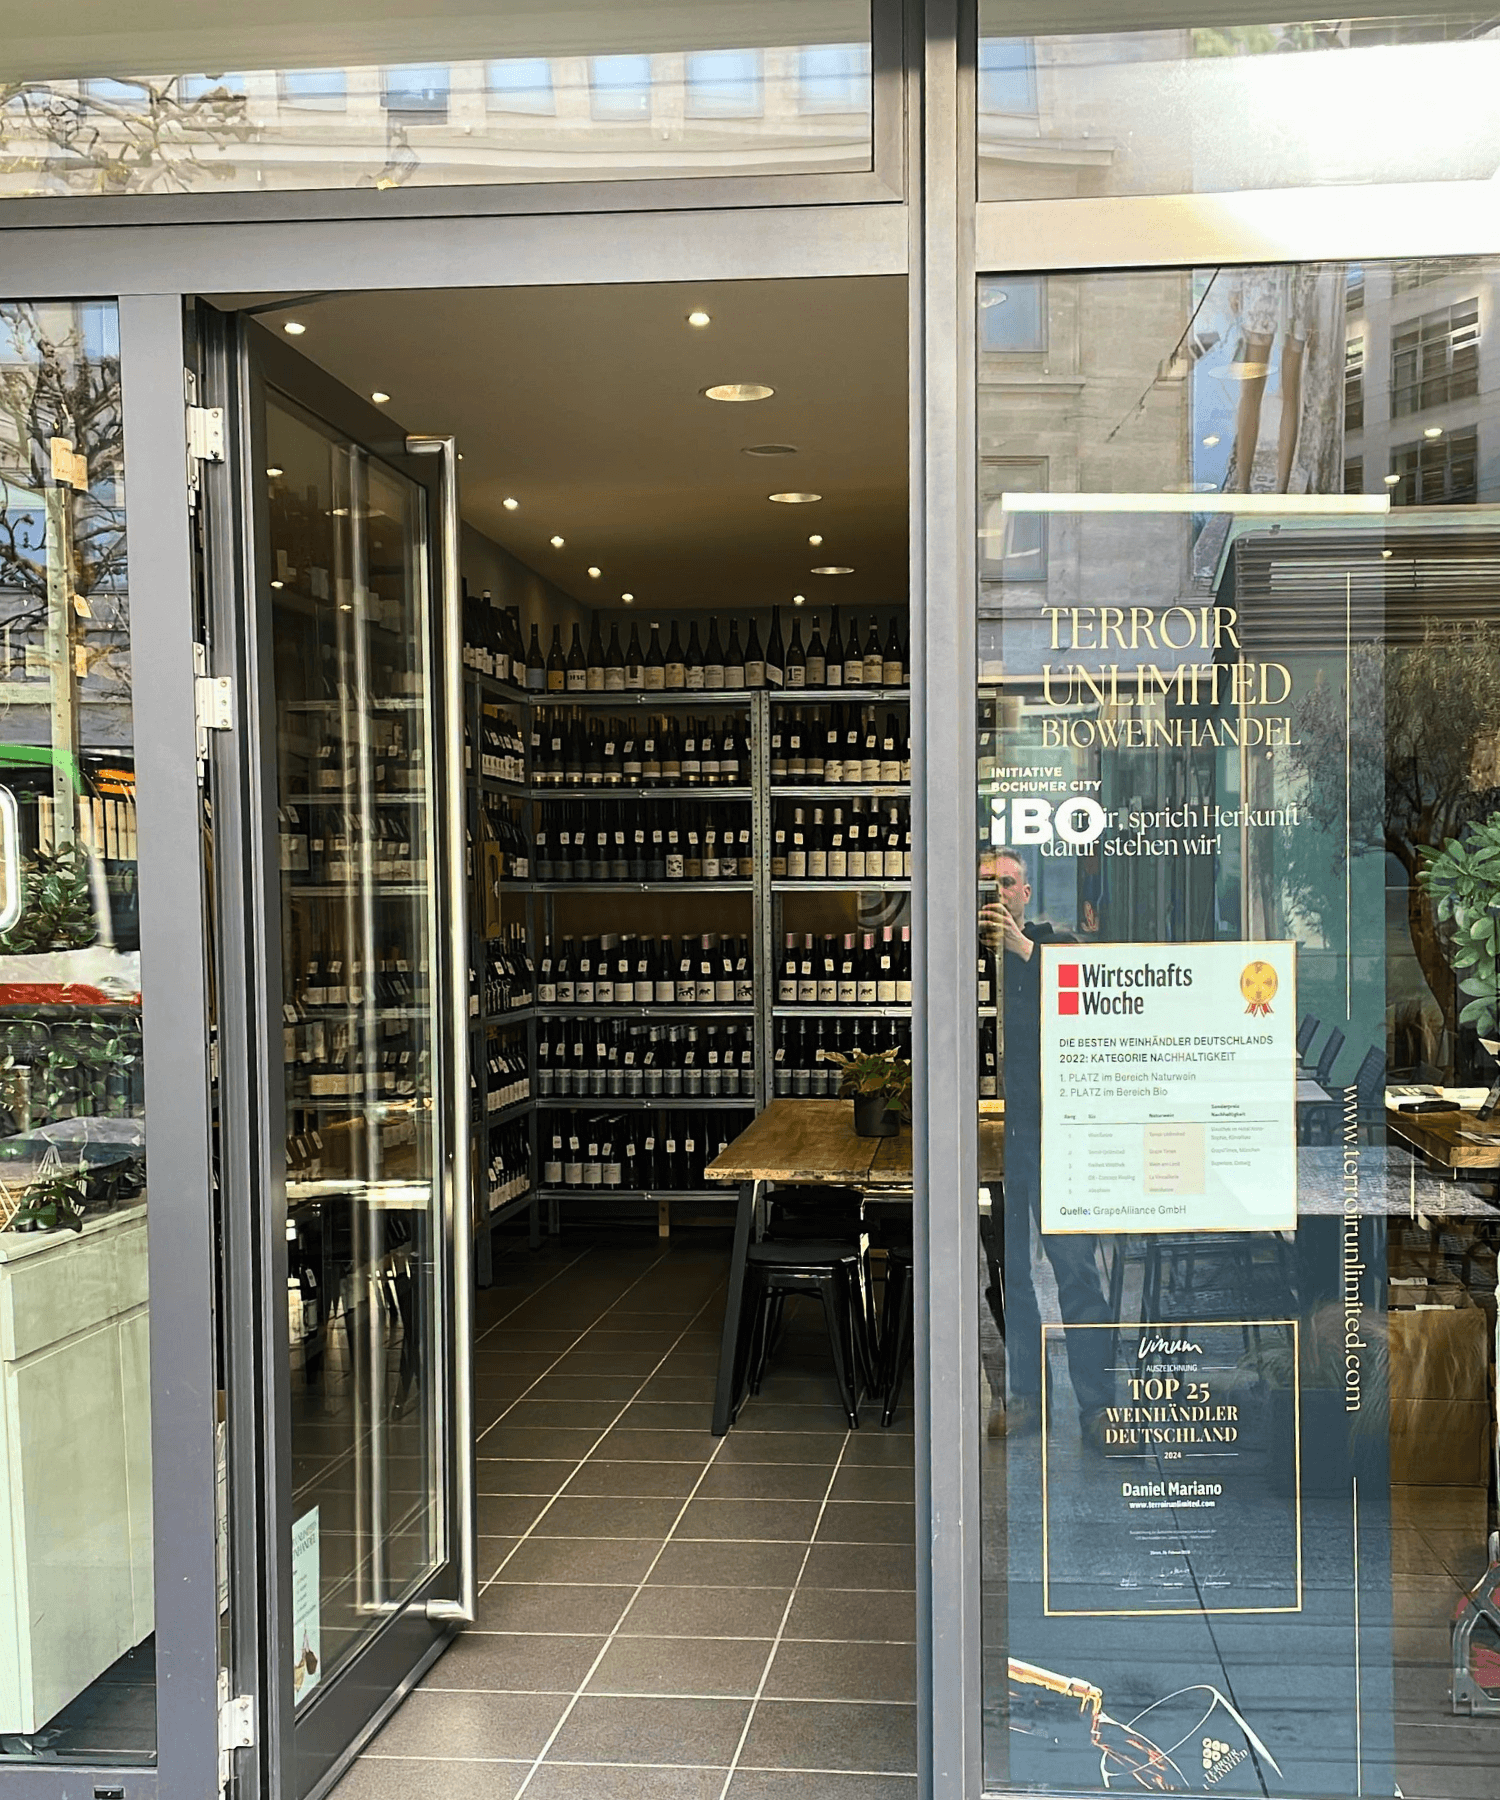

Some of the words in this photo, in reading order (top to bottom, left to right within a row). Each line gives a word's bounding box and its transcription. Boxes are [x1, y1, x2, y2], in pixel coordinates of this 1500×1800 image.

[1041, 606, 1242, 650] TERROIR
[1042, 663, 1292, 707] UNLIMITED
[1041, 717, 1301, 749] BIOWEINHANDEL
[991, 766, 1063, 778] INITIATIVE
[991, 780, 1067, 793] BOCHUMER
[1070, 779, 1102, 792] CITY
[1129, 803, 1198, 835] sprich
[1203, 802, 1301, 828] Herkunft
[1104, 834, 1179, 857] stehen
[1183, 834, 1222, 856] wir!
[1082, 963, 1193, 988] Wirtschafts
[1083, 991, 1144, 1015] Woche
[1059, 1038, 1076, 1048] DIE
[1078, 1037, 1117, 1047] BESTEN
[1119, 1035, 1192, 1047] WEINHÄNDLER
[1194, 1035, 1274, 1046] DEUTSCHLANDS
[1059, 1053, 1089, 1064] 2022:
[1091, 1053, 1148, 1063] KATEGORIE
[1150, 1052, 1236, 1062] NACHHALTIGKEIT
[1060, 1073, 1067, 1082] 1.
[1069, 1072, 1100, 1082] PLATZ
[1102, 1073, 1112, 1082] im
[1115, 1072, 1149, 1082] Bereich
[1151, 1071, 1196, 1081] Naturwein
[1060, 1088, 1068, 1097] 2.
[1071, 1088, 1101, 1098] PLATZ
[1103, 1088, 1114, 1097] im
[1117, 1087, 1151, 1097] Bereich
[1153, 1087, 1168, 1097] Bio
[1060, 1206, 1091, 1217] Quelle:
[1093, 1206, 1156, 1217] GrapeAlliance
[1158, 1205, 1186, 1215] GmbH
[1343, 1084, 1367, 1413] www.terroirunlimited.com
[1146, 1364, 1198, 1373] AUSZEICHNUNG
[1128, 1378, 1180, 1401] TOP
[1186, 1382, 1211, 1404] 25
[1105, 1404, 1239, 1424] WEINHÄNDLER
[1105, 1427, 1238, 1445] DEUTSCHLAND
[1164, 1451, 1182, 1460] 2024
[1122, 1482, 1166, 1498] Daniel
[1168, 1481, 1223, 1497] Mariano
[1129, 1499, 1216, 1509] www.terroirunlimited.com
